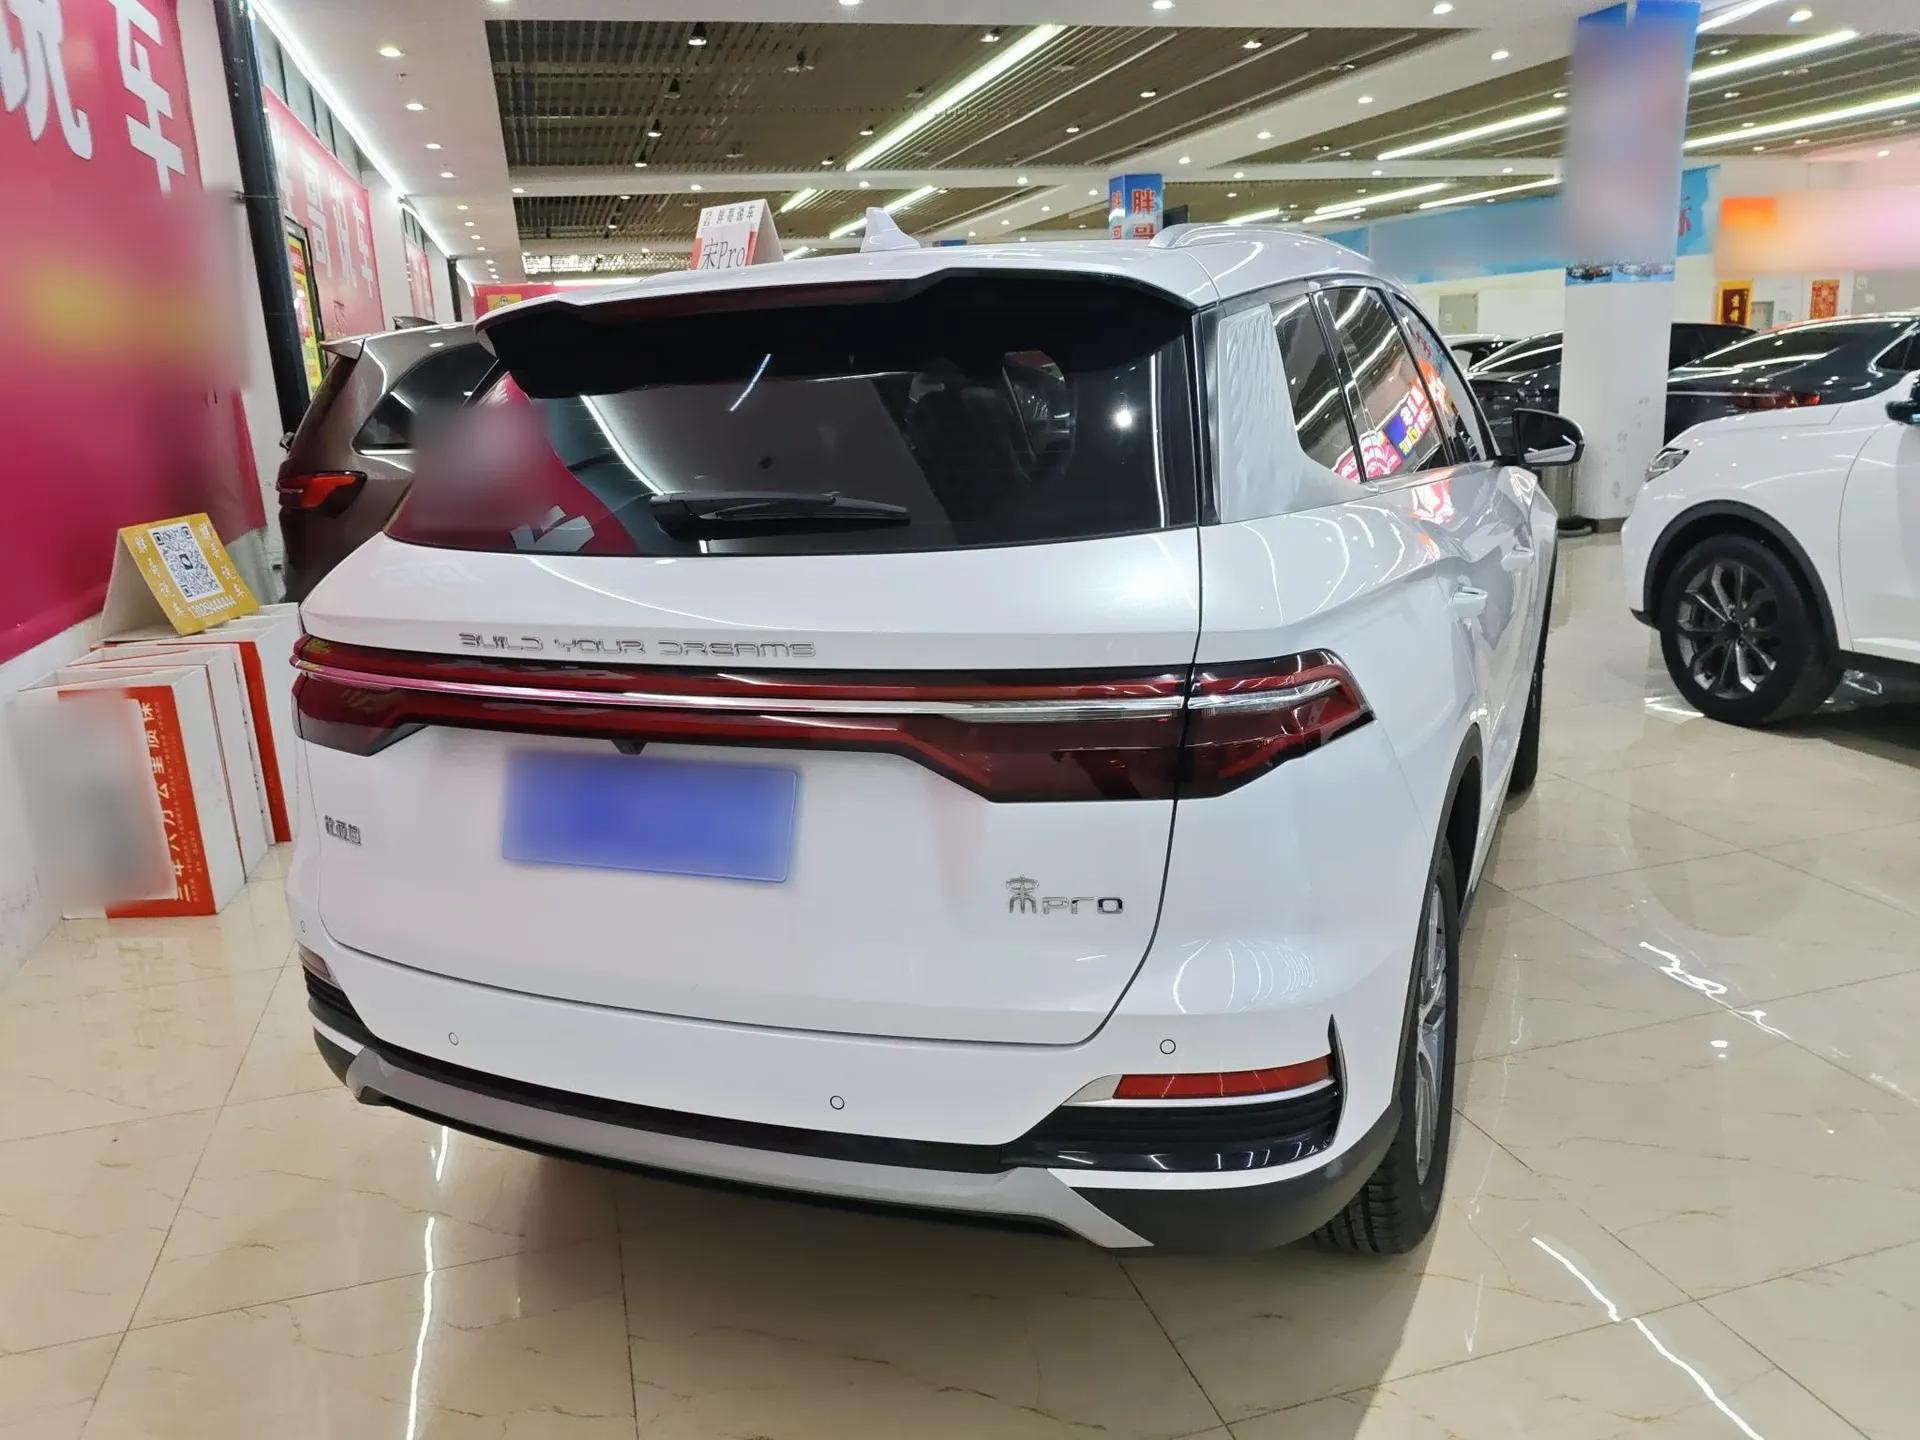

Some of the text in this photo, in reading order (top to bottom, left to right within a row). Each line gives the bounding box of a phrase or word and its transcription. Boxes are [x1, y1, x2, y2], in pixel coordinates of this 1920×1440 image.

[701, 238, 746, 269] 宋Pro
[459, 632, 816, 658] BUILD YOUR DREAMS
